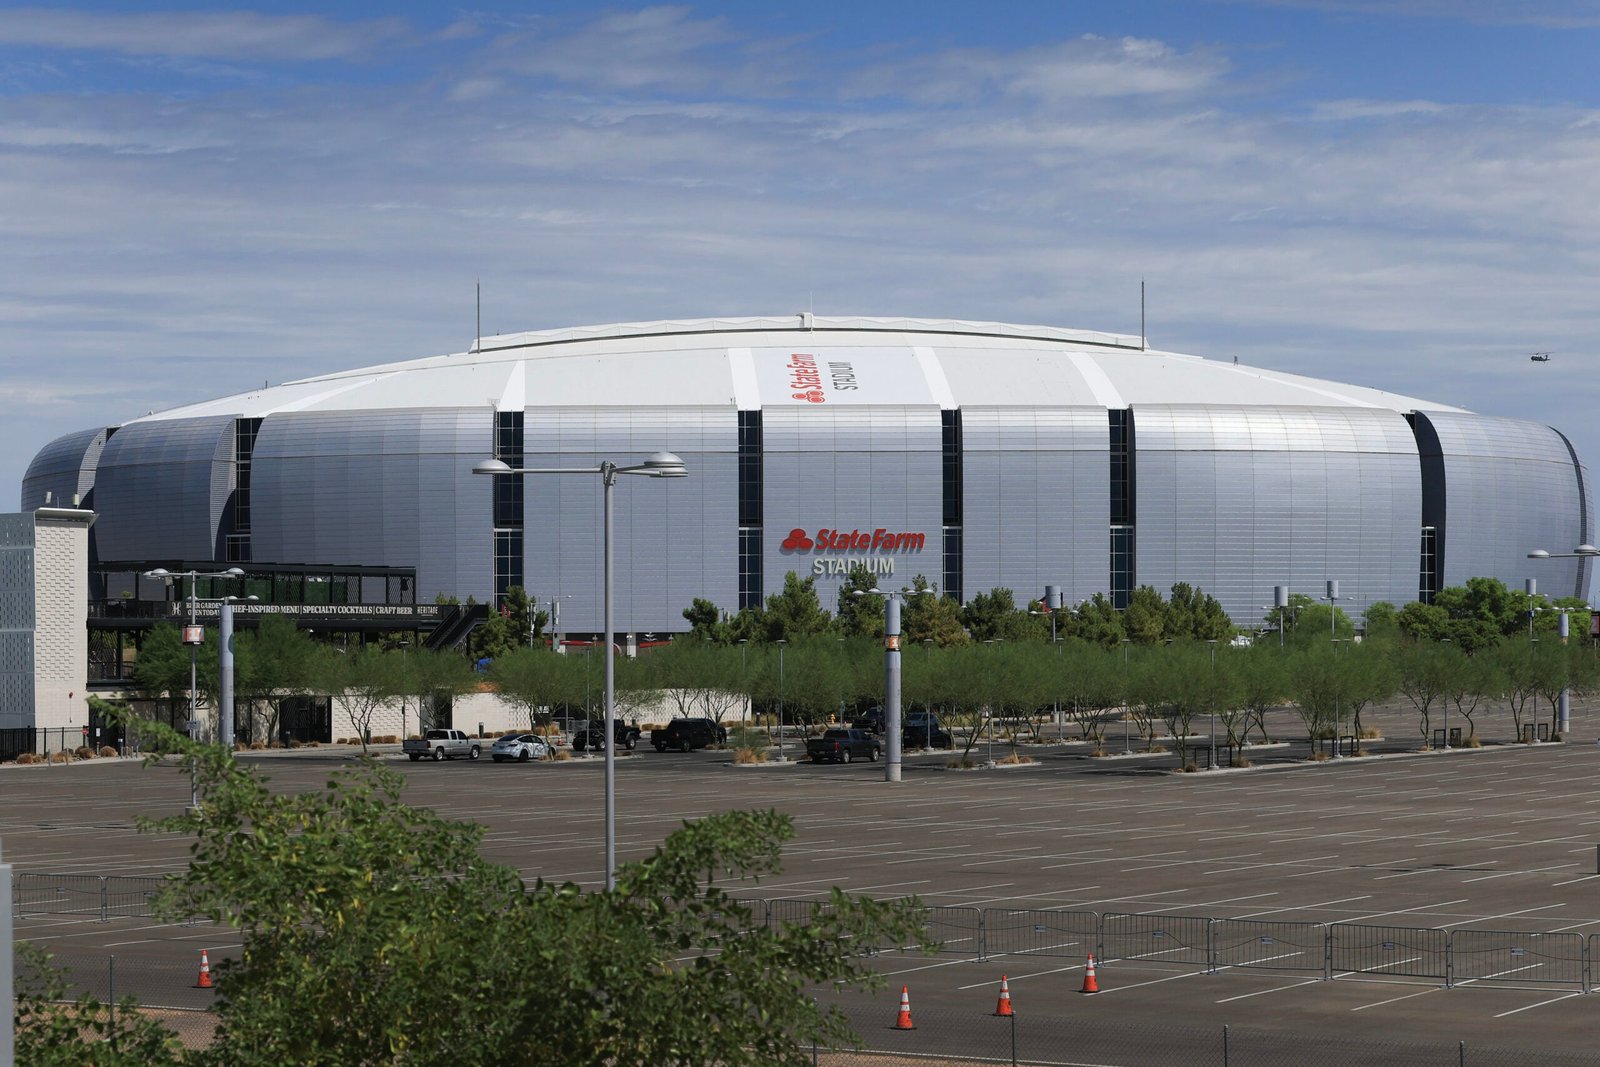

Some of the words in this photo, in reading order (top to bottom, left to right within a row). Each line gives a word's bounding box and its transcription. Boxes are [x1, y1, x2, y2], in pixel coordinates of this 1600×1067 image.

[827, 361, 859, 391] STADIUM
[231, 604, 280, 613] HEF-INSPIRED
[280, 605, 300, 614] MENU
[302, 605, 337, 614] SPECIALTY
[337, 605, 373, 614] COCKTAILS
[375, 606, 396, 614] CRAFT
[396, 606, 413, 615] BEER
[417, 606, 438, 615] HERITAGE
